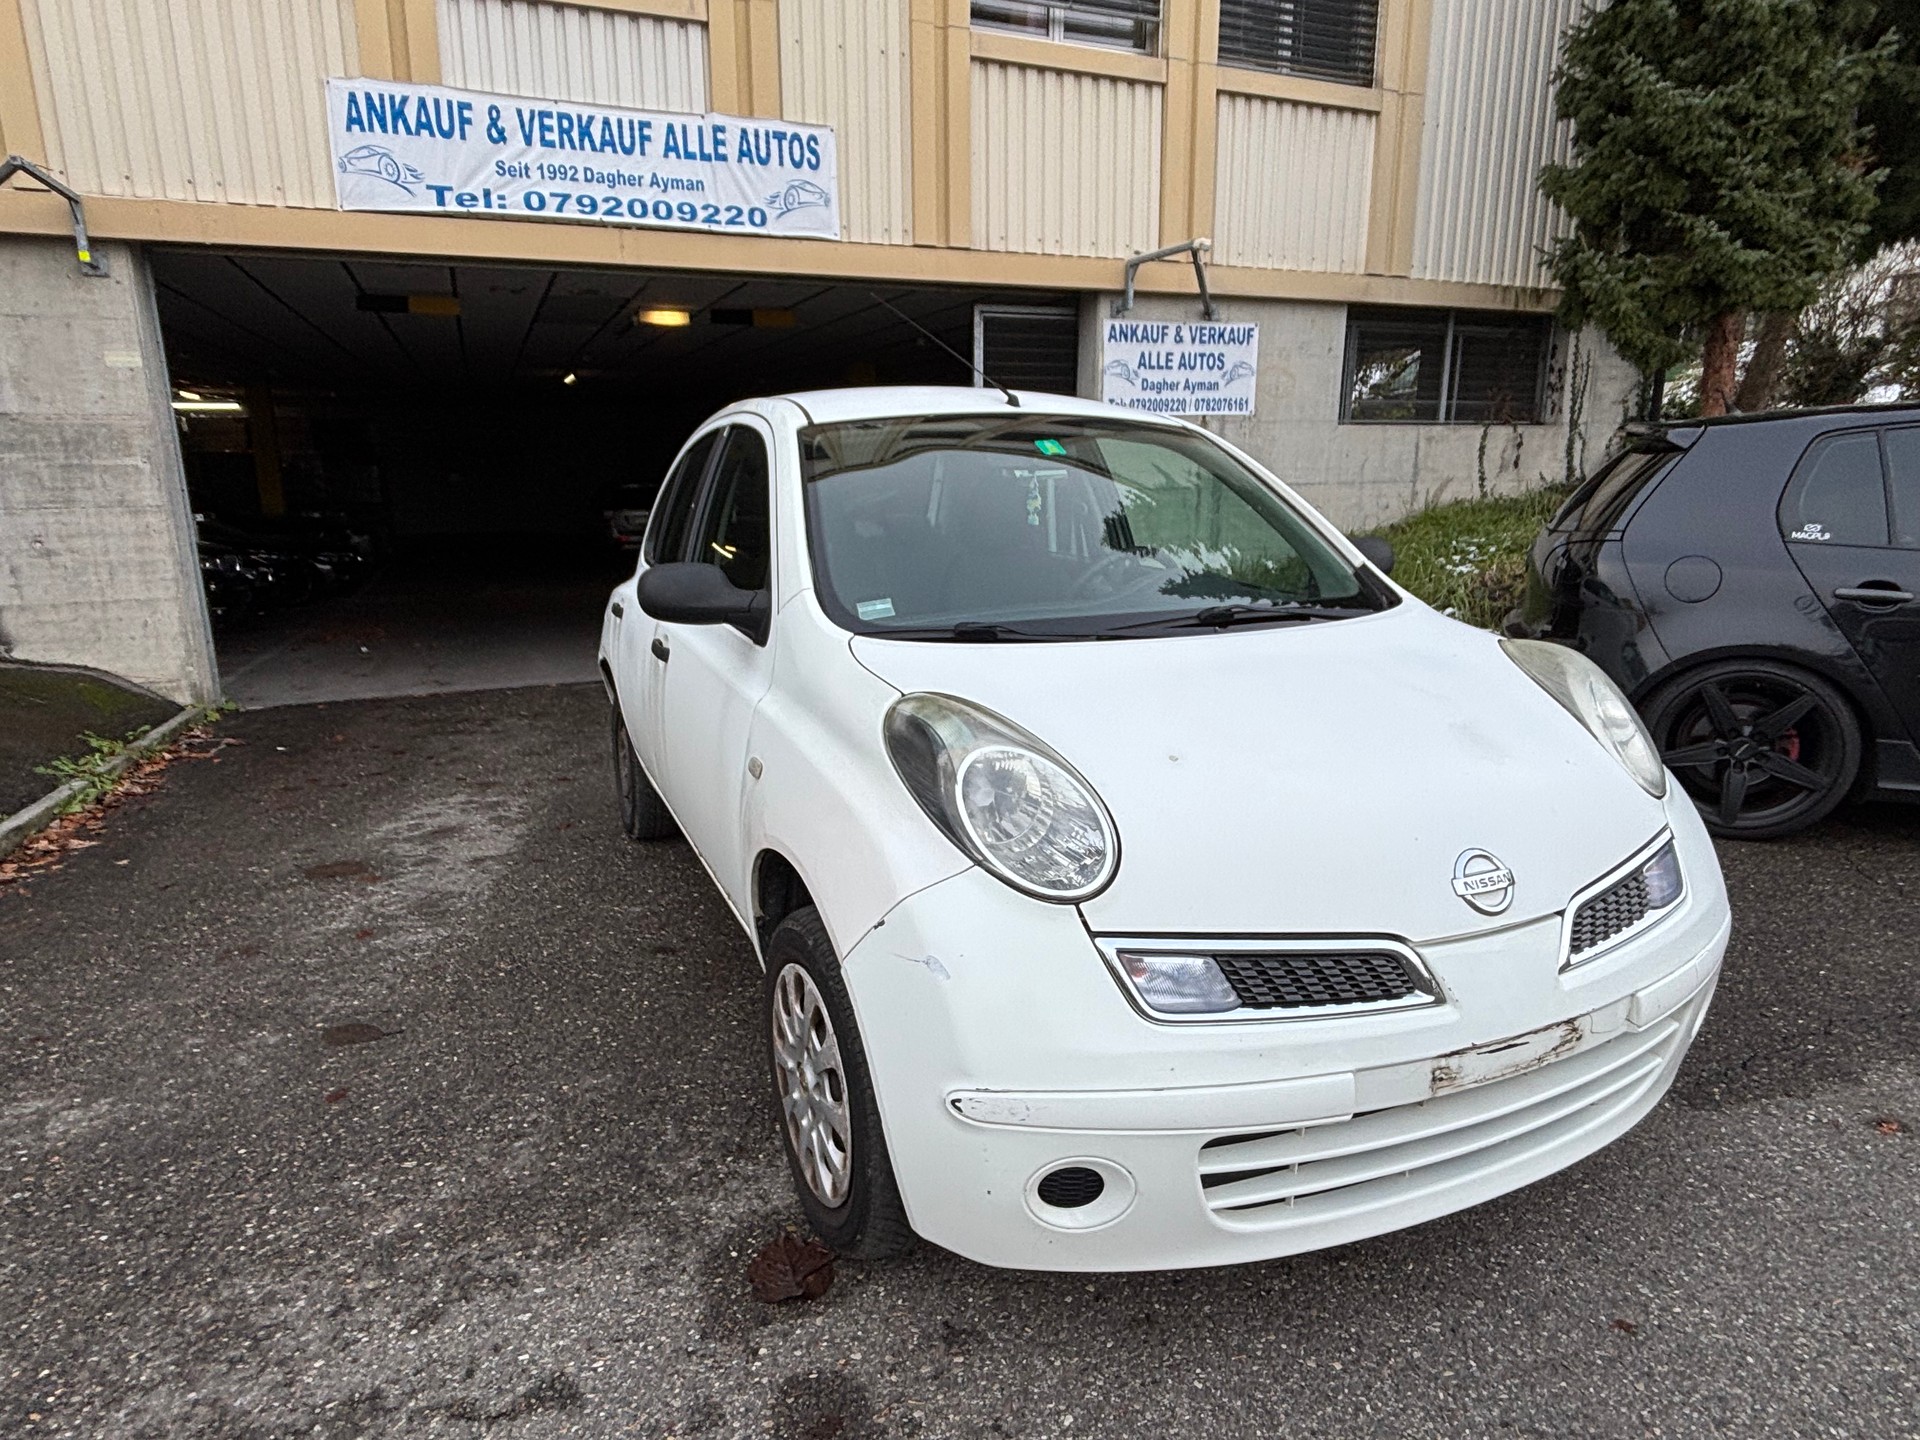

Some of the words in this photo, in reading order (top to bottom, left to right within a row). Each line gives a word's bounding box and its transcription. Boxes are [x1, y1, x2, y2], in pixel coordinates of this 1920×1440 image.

[346, 91, 473, 141] ANKAUF
[486, 104, 507, 145] &
[515, 107, 652, 156] VERKAUF
[663, 122, 729, 163] ALLE
[737, 127, 821, 171] AUTOS
[495, 160, 531, 179] Seit
[536, 163, 579, 182] 1992
[583, 167, 644, 189] Dagher
[649, 172, 705, 193] Ayman
[426, 184, 507, 209] Tel:
[523, 190, 768, 228] 0792009220
[1108, 323, 1169, 344] ANKAUF
[1174, 325, 1184, 344] &
[1189, 325, 1255, 346] VERKAUF
[1137, 351, 1174, 370] ALLE
[1177, 352, 1226, 371] AUTOS
[1141, 378, 1180, 394] Dagher
[1183, 378, 1220, 394] Ayman
[1188, 398, 1193, 412] /
[1194, 397, 1249, 412] 0782076161
[1463, 871, 1511, 891] NISSAN
